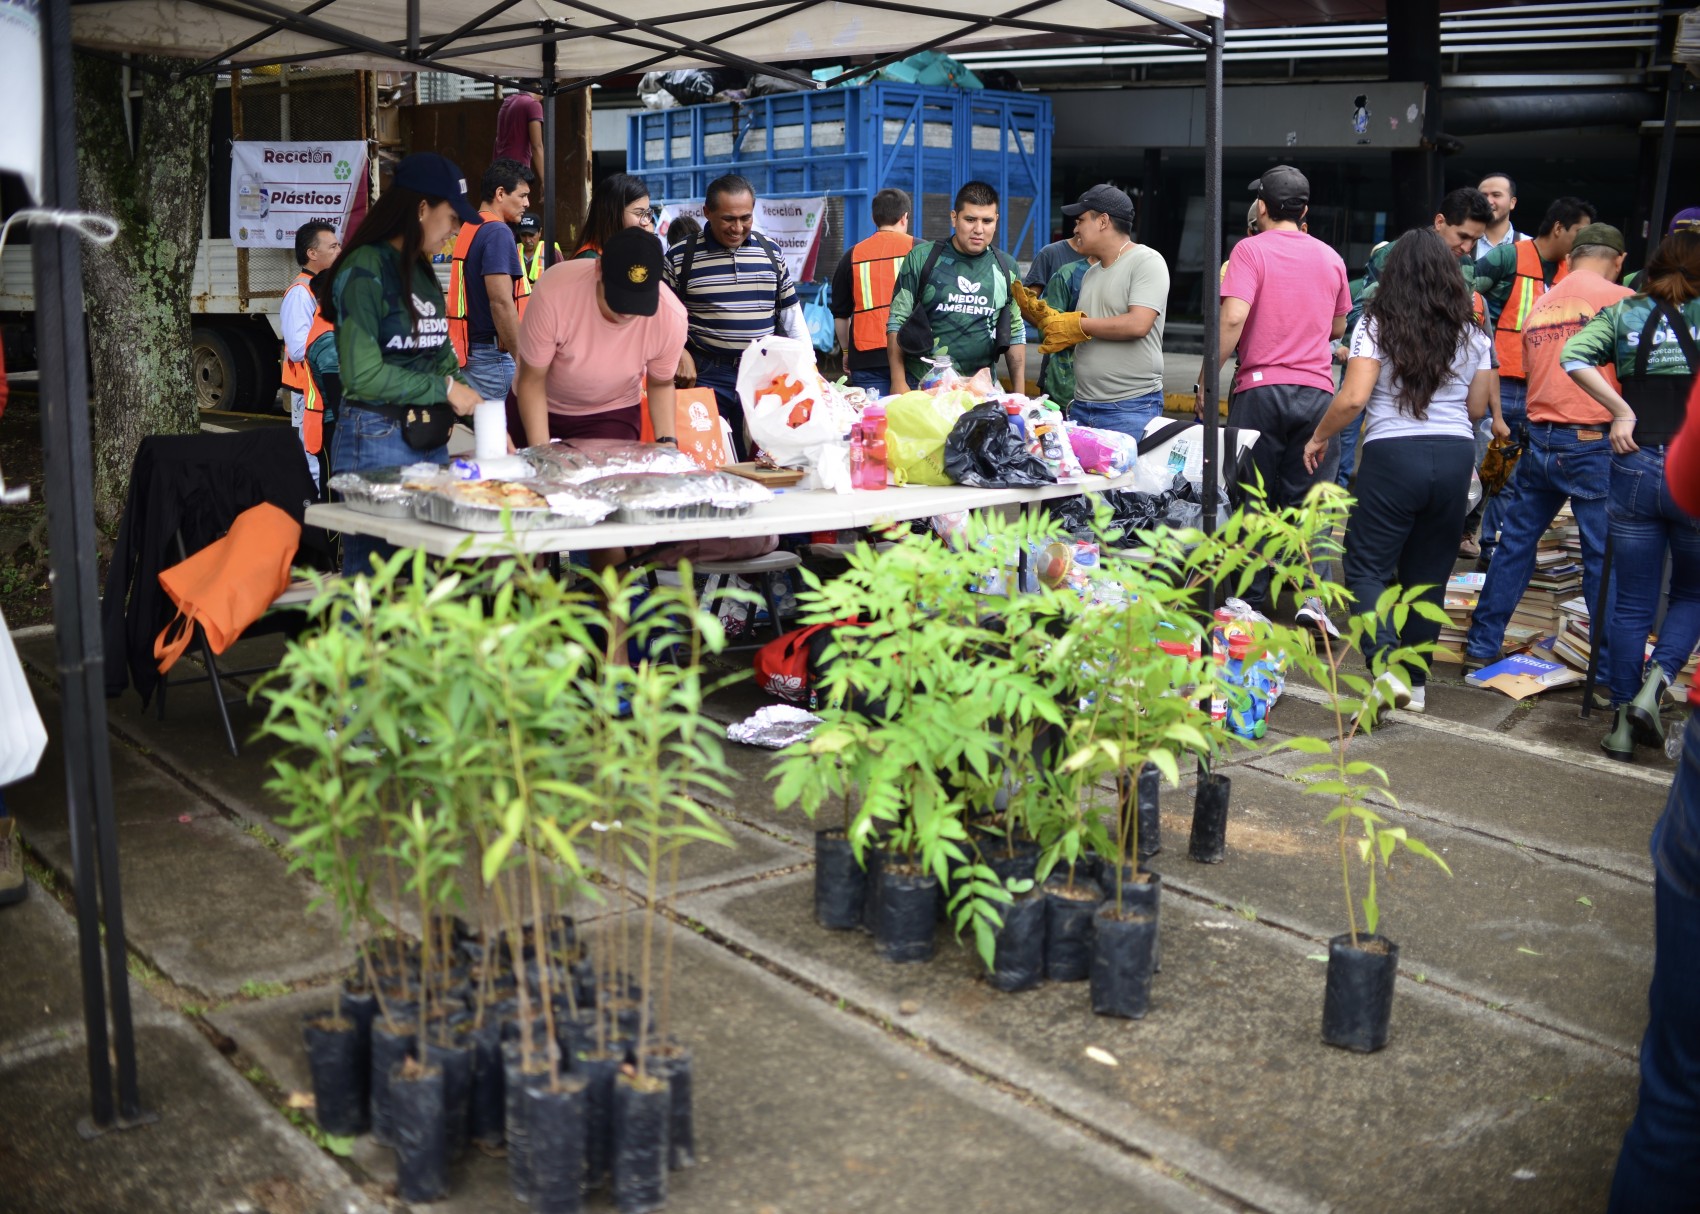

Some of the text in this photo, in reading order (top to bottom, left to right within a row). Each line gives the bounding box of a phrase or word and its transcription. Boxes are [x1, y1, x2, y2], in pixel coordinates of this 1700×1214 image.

[270, 191, 342, 205] Plásticos
[948, 293, 988, 305] MEDIO
[936, 303, 995, 316] AMBIENTE
[386, 335, 447, 349] AMBIEN
